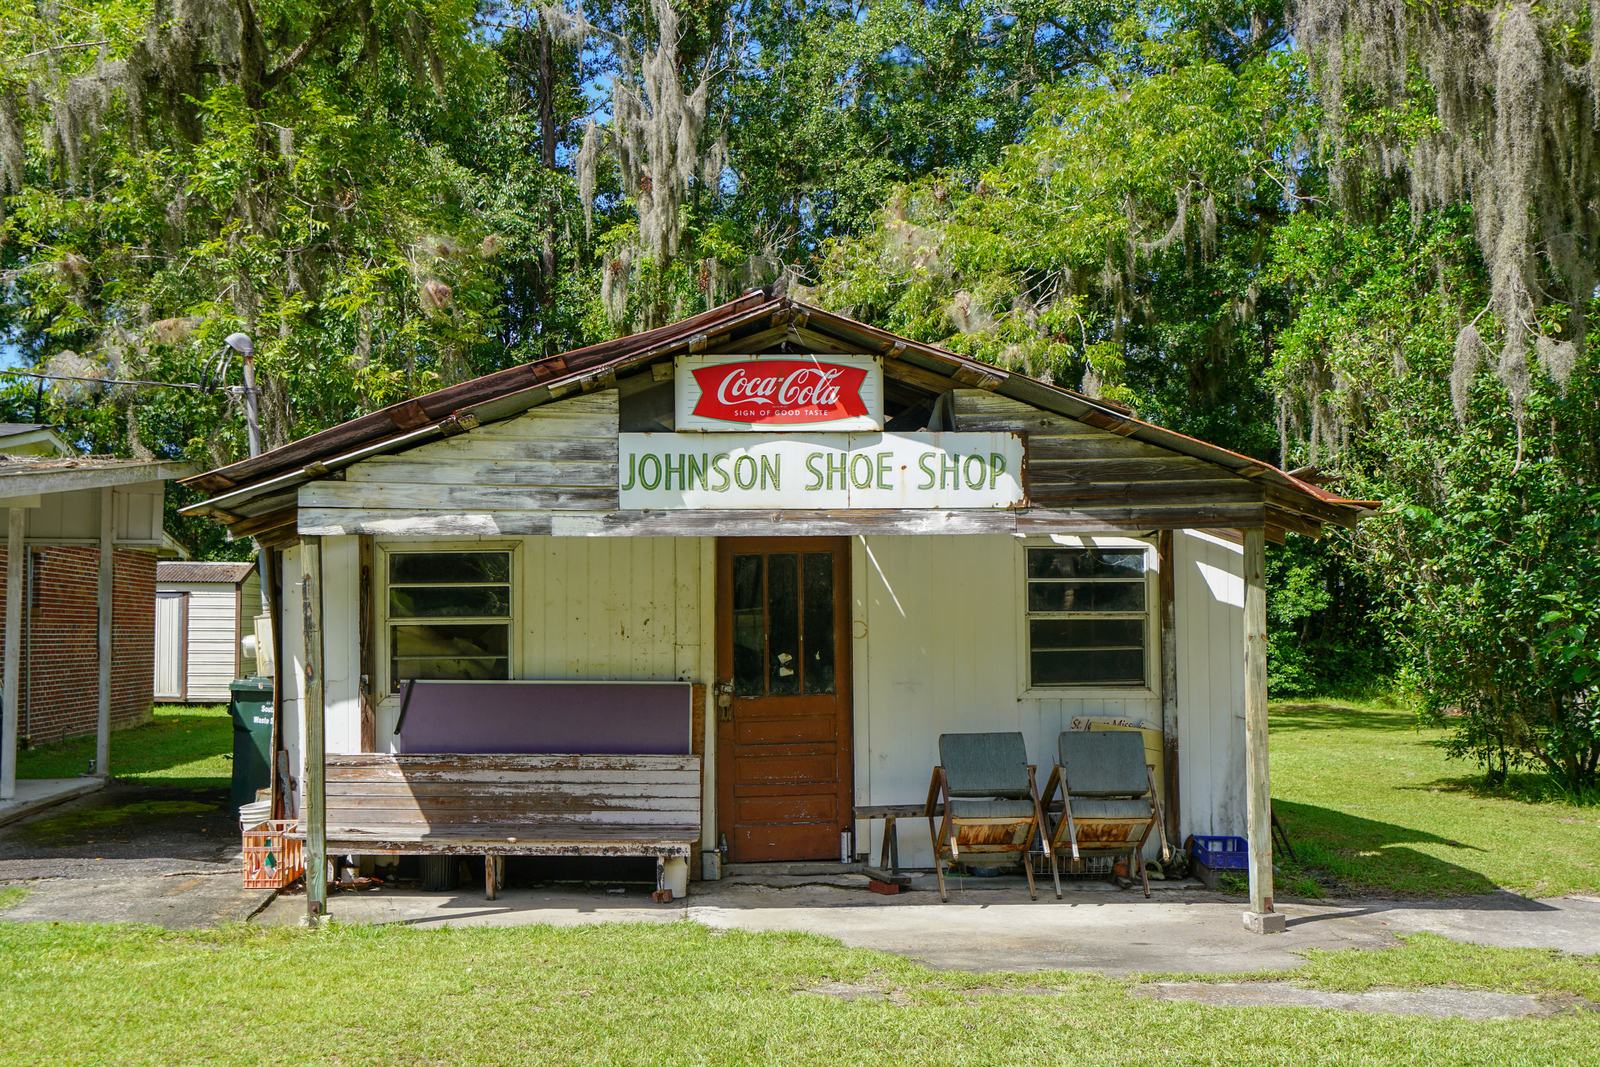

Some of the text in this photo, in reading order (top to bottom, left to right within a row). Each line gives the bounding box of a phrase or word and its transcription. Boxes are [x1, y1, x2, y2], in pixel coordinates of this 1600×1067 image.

[717, 368, 845, 405] Coca-Cola
[621, 451, 1007, 492] JOHNSON SHOE SHOP
